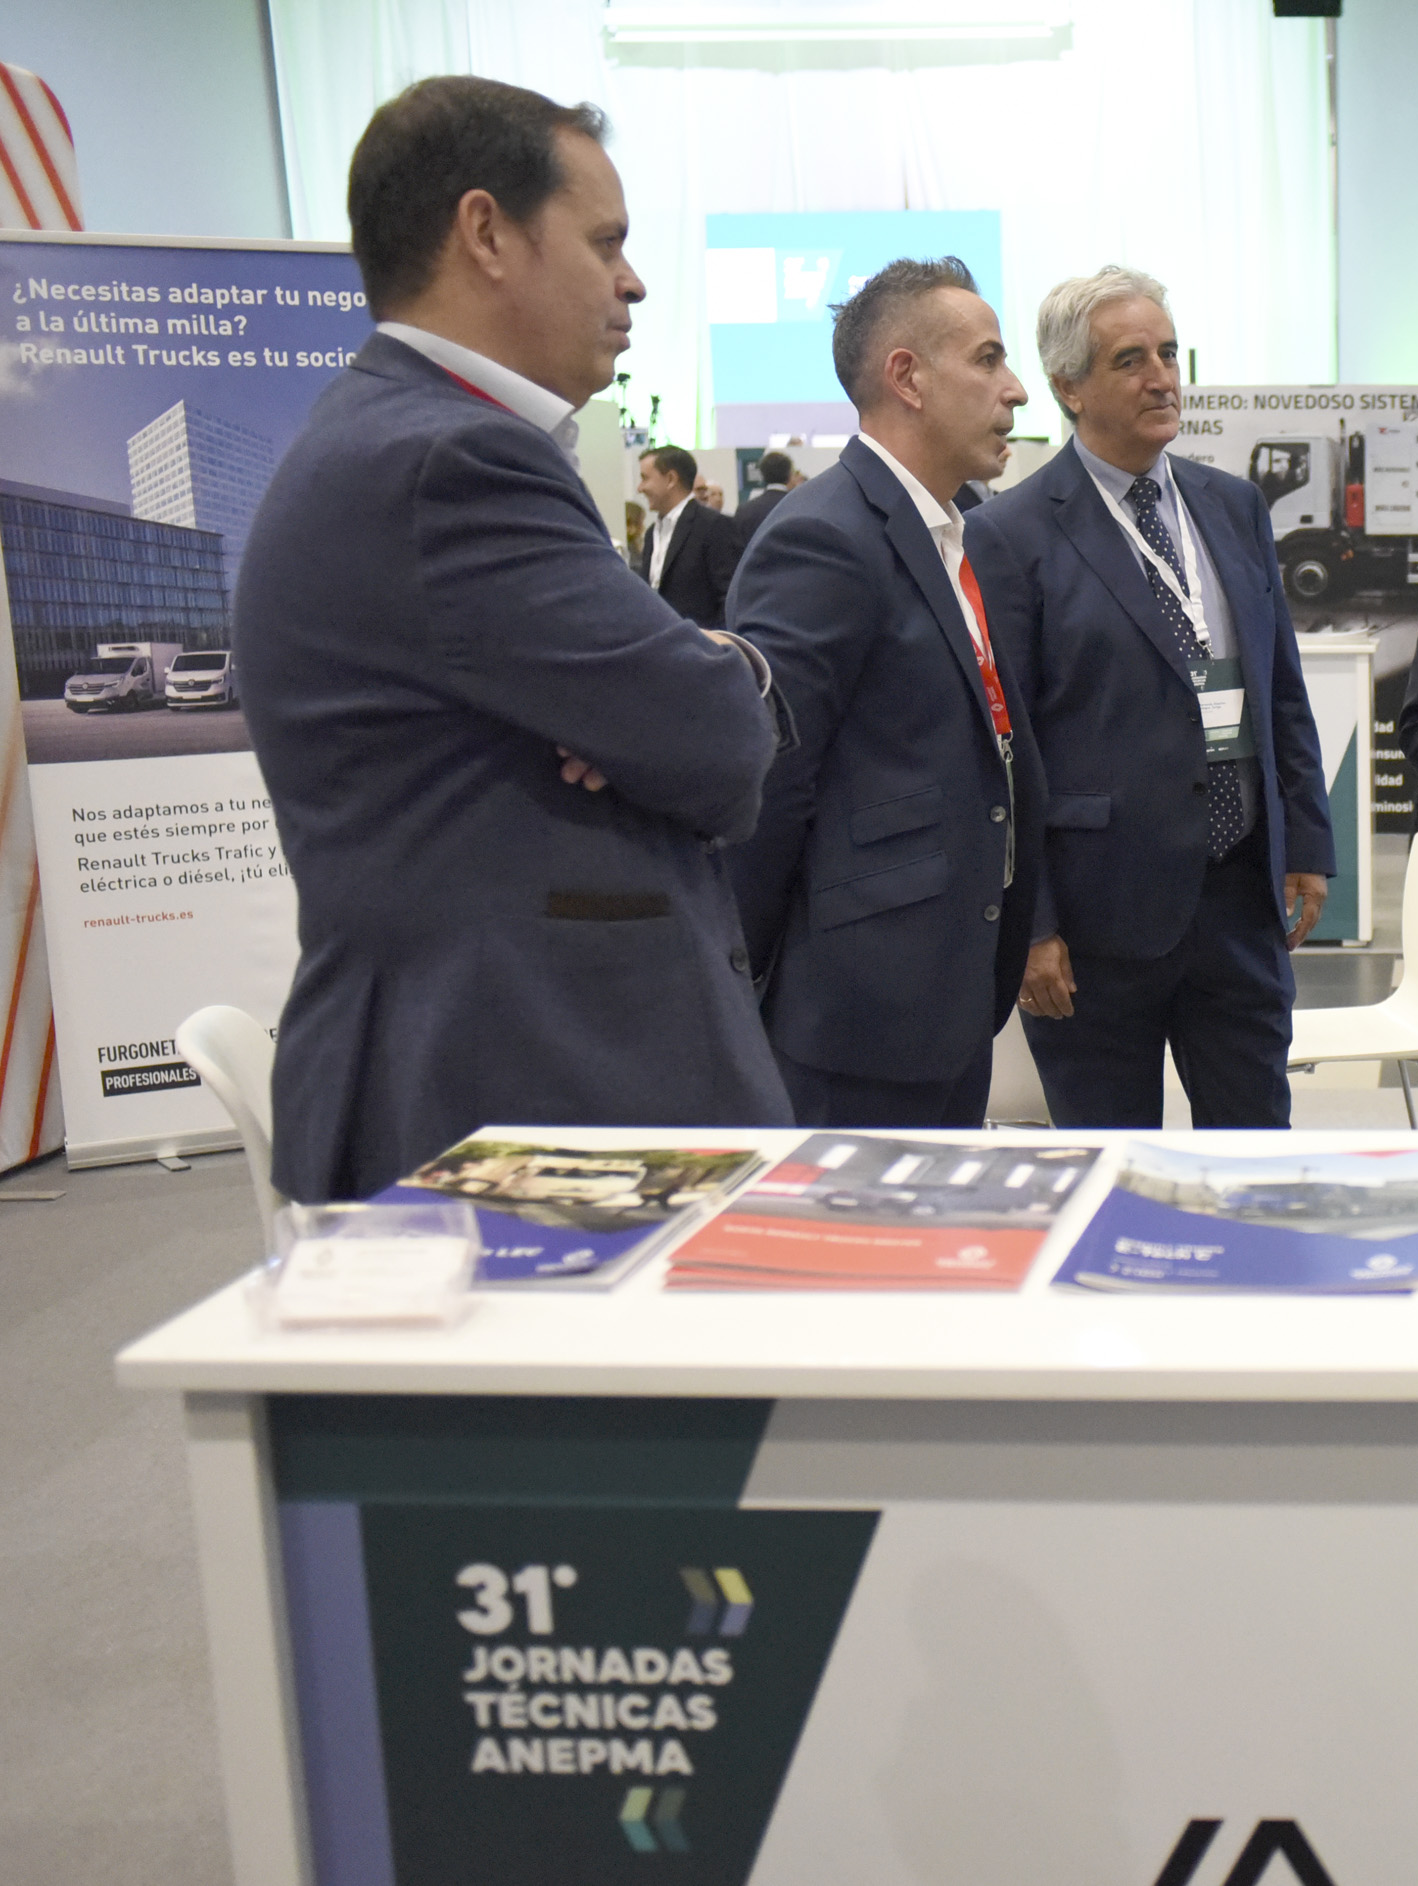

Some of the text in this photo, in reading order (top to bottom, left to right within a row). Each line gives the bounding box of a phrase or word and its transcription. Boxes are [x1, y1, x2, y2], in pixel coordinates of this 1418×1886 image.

[12, 278, 161, 304] ¿Necesitas
[168, 283, 267, 308] adaptar
[275, 288, 299, 307] tu
[16, 310, 247, 336] a la última milla?
[20, 342, 125, 365] Renault
[132, 344, 220, 366] Trucks
[228, 350, 257, 367] es
[263, 348, 289, 367] tu
[1254, 394, 1354, 410] NOVEDOSO
[72, 808, 107, 822] Nos
[112, 801, 209, 821] adaptamos
[214, 801, 224, 813] a
[229, 798, 246, 811] tu
[74, 819, 269, 847] que estés siempre por
[78, 844, 277, 871] Renault Trucks Trafic y
[80, 873, 157, 893] eléctrica
[163, 875, 173, 886] o
[178, 868, 235, 885] diésel,
[269, 863, 293, 879] eli
[84, 909, 194, 928] renault-trucks.es
[98, 1039, 180, 1063] FURGONET
[105, 1067, 197, 1090] PROFESIONALES
[463, 1646, 734, 1686] JORNADAS
[464, 1684, 718, 1731] TÉCNICAS
[471, 1737, 693, 1776] ANEPMA
